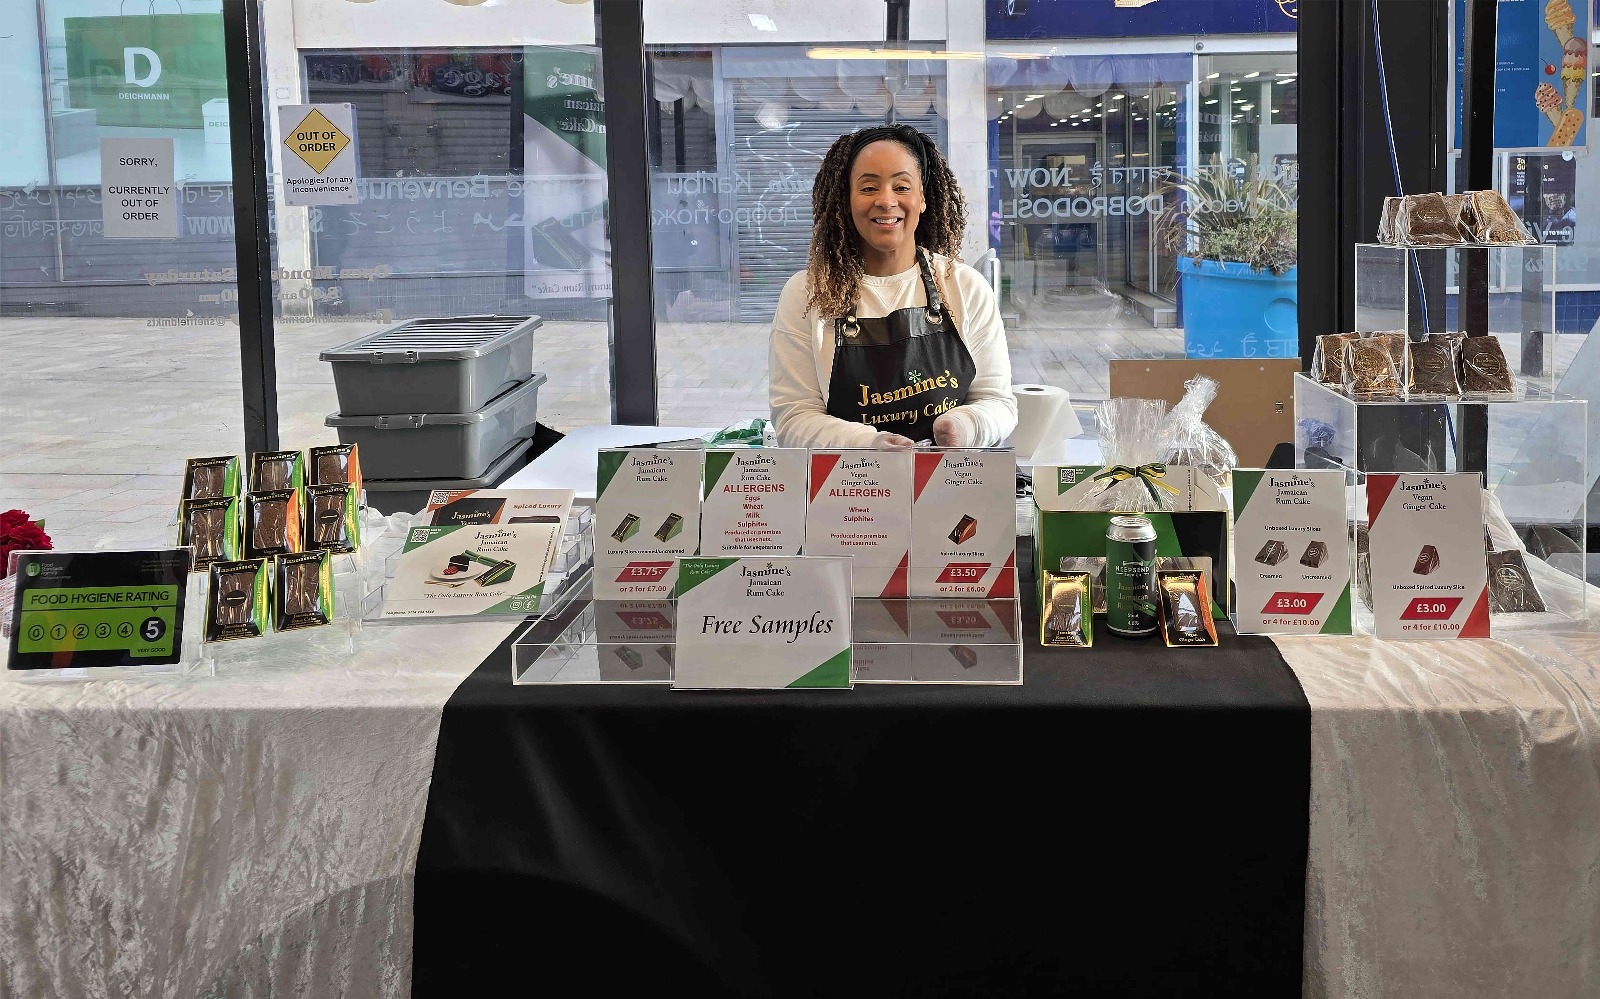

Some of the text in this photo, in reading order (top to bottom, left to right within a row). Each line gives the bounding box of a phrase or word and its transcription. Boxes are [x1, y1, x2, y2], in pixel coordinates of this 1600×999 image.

[124, 47, 161, 87] D
[297, 132, 336, 140] OUT OF
[299, 143, 336, 152] ORDER
[119, 158, 157, 167] SORRY,
[287, 176, 353, 186] Apologies for any
[109, 187, 170, 195] CURRENTLY
[122, 199, 159, 207] OUT OF
[123, 212, 159, 220] ORDER
[858, 370, 959, 407] Jasmine's
[861, 397, 958, 425] Luxury Cakes
[631, 456, 674, 467] Jasmine's
[736, 456, 777, 466] Jasmine's
[840, 459, 881, 469] Jasmine's
[943, 458, 984, 469] Jasmine's
[638, 467, 666, 475] Jamaican
[742, 467, 769, 475] Jamaican
[944, 479, 966, 487] Ginger
[1269, 476, 1316, 488] Jasmine's
[1400, 480, 1447, 492] Jasmine's
[723, 484, 786, 493] ALLERGENS
[829, 489, 891, 497] ALLERGENS
[1277, 489, 1308, 497] Jamaican
[1413, 494, 1433, 502] Vegan
[1402, 503, 1447, 512] Ginger Cake
[451, 511, 491, 520] Jasmine's
[474, 530, 518, 540] Jasmine's
[282, 554, 322, 565] Jasmine's
[216, 564, 258, 574] Jasmine's
[740, 565, 792, 578] Jasmine's
[950, 569, 977, 577] £3.50
[748, 579, 782, 588] Jamaican
[766, 589, 785, 597] Cake
[1118, 593, 1149, 601] Jamaican
[31, 591, 169, 605] FOOD HYGIENE RATING
[1277, 598, 1307, 608] £3.00
[1417, 603, 1447, 613] £3.00
[32, 628, 40, 638] 0
[78, 627, 85, 636] 2
[100, 626, 107, 635] 3
[121, 625, 129, 634] 4
[145, 620, 159, 639] 5
[700, 611, 834, 644] Free Samples
